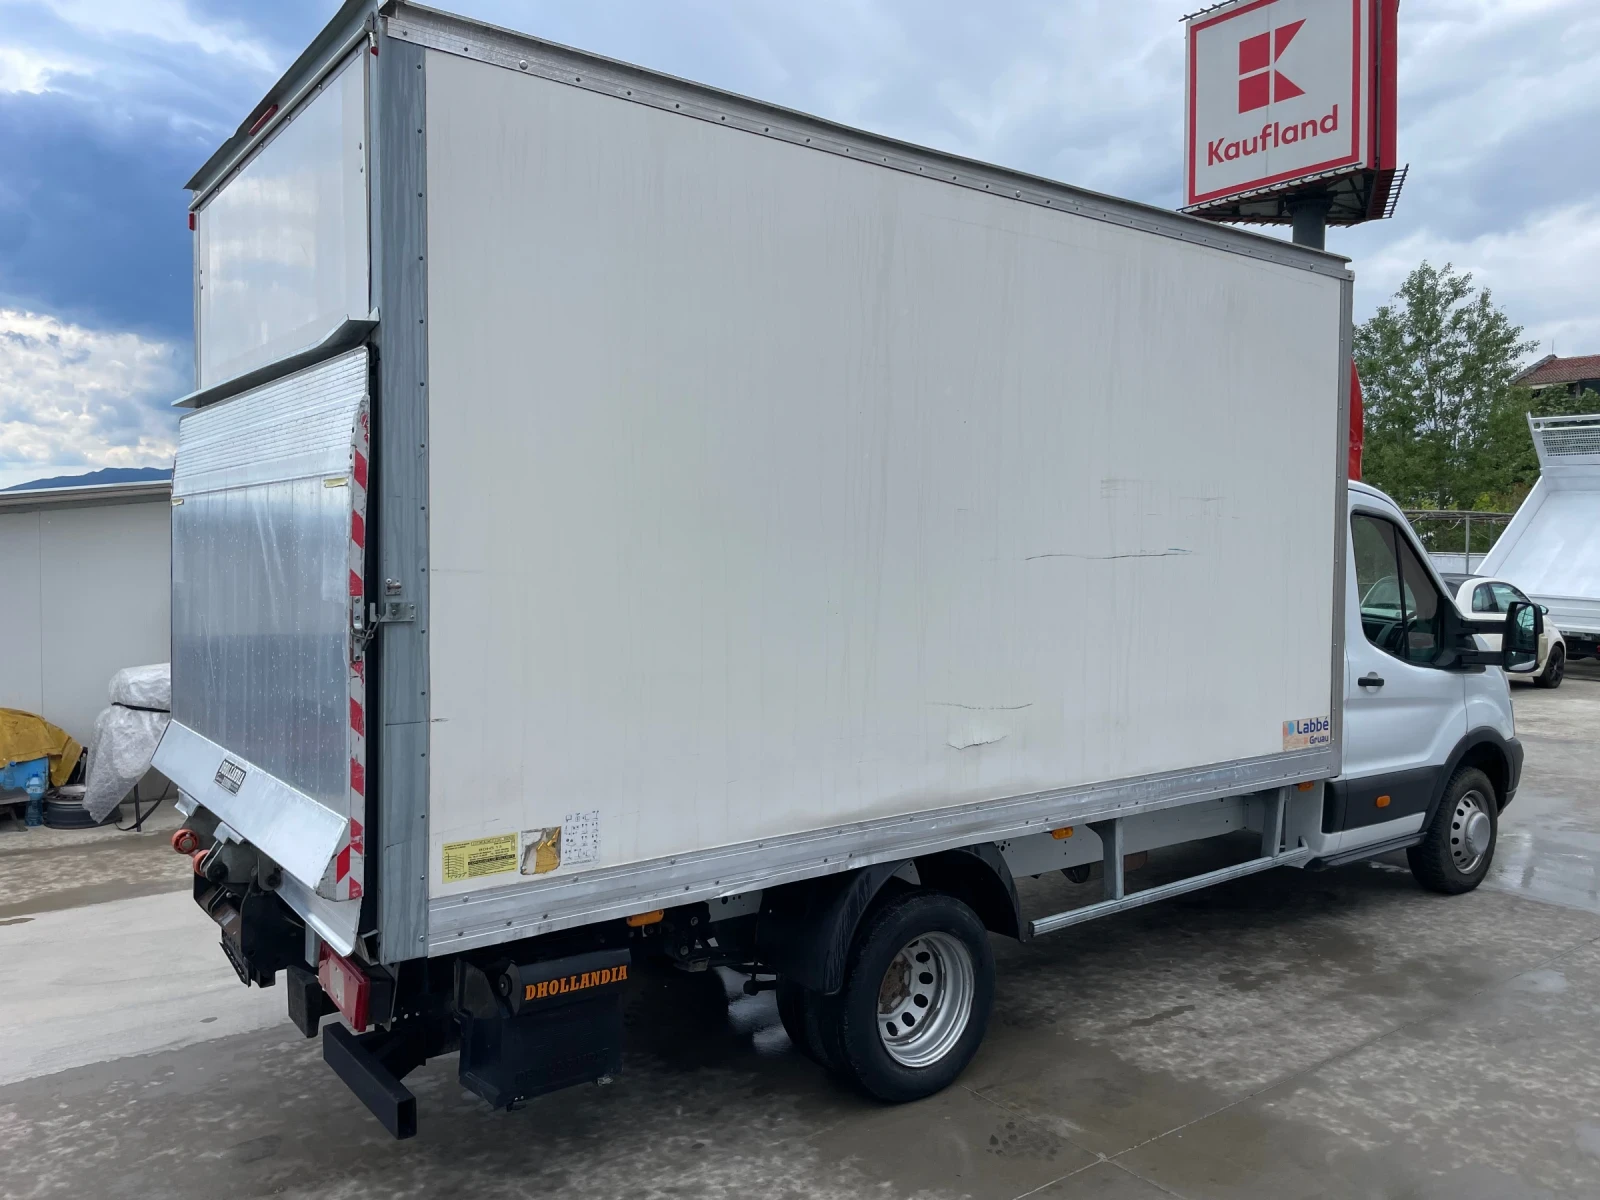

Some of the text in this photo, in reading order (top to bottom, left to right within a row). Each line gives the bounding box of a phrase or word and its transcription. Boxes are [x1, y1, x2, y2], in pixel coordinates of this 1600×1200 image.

[1207, 104, 1338, 166] Kaufland
[1296, 716, 1329, 734] Labbé
[1309, 735, 1329, 744] Gruau
[525, 965, 628, 1001] DHOLLANDIA
